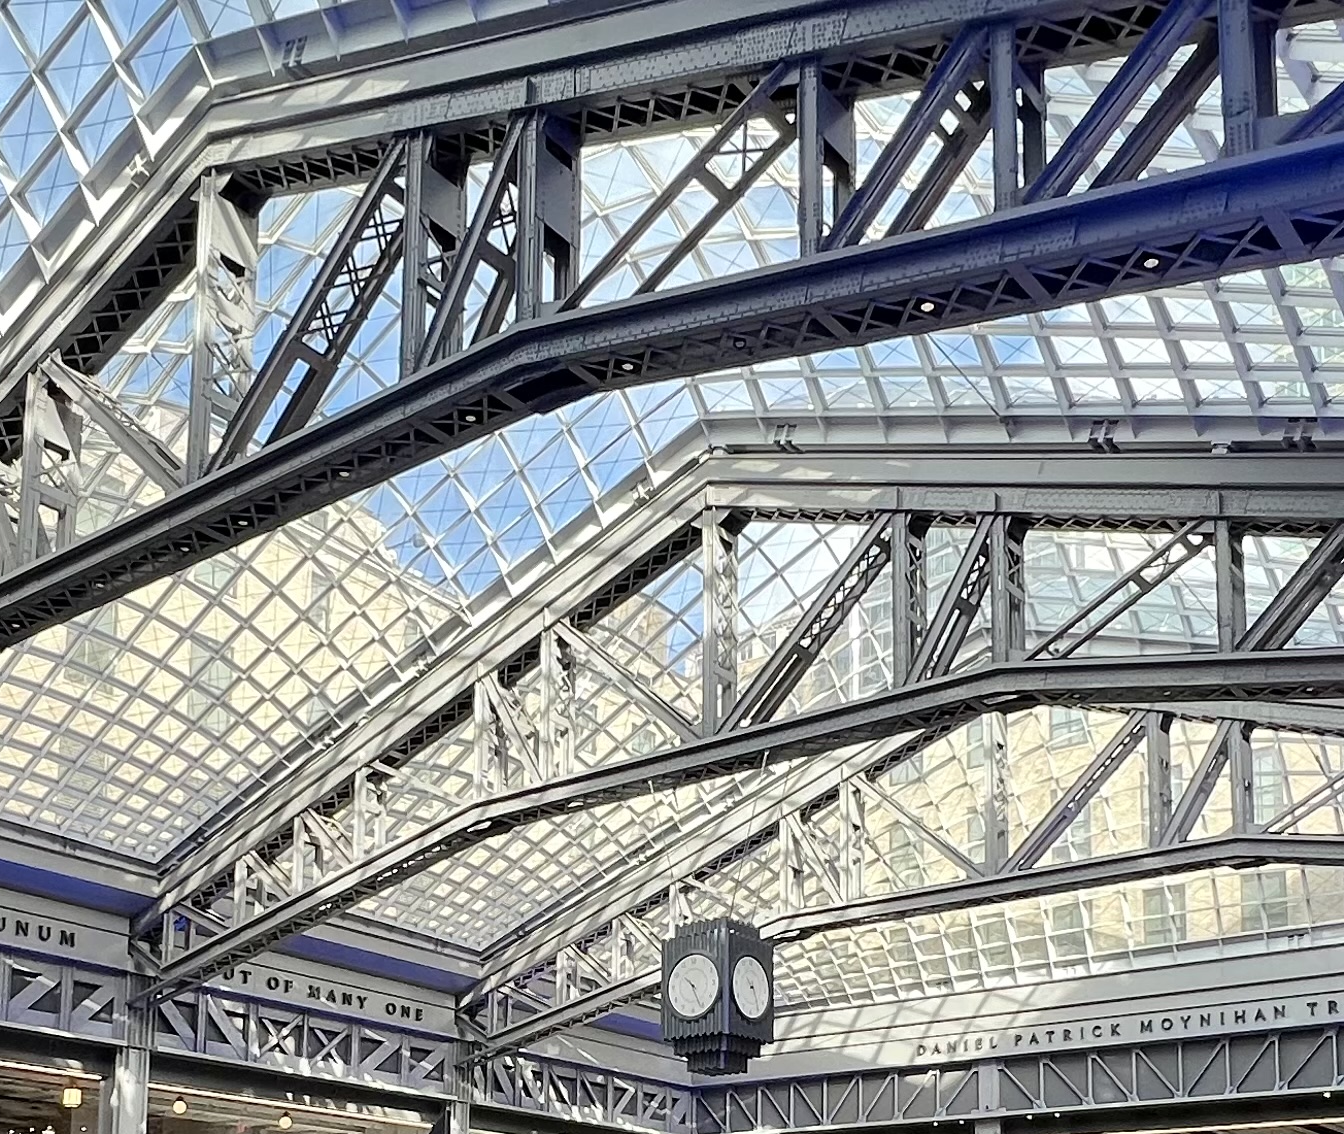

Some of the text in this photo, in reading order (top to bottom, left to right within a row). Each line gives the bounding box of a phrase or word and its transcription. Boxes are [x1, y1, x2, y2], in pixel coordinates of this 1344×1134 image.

[266, 976, 294, 994] OF
[307, 985, 369, 1010] MANY
[385, 1002, 424, 1022] ONE
[916, 1035, 998, 1058] DANIEL
[1014, 1023, 1123, 1047] PATRICK
[1140, 1005, 1287, 1034] MOYNIHAN
